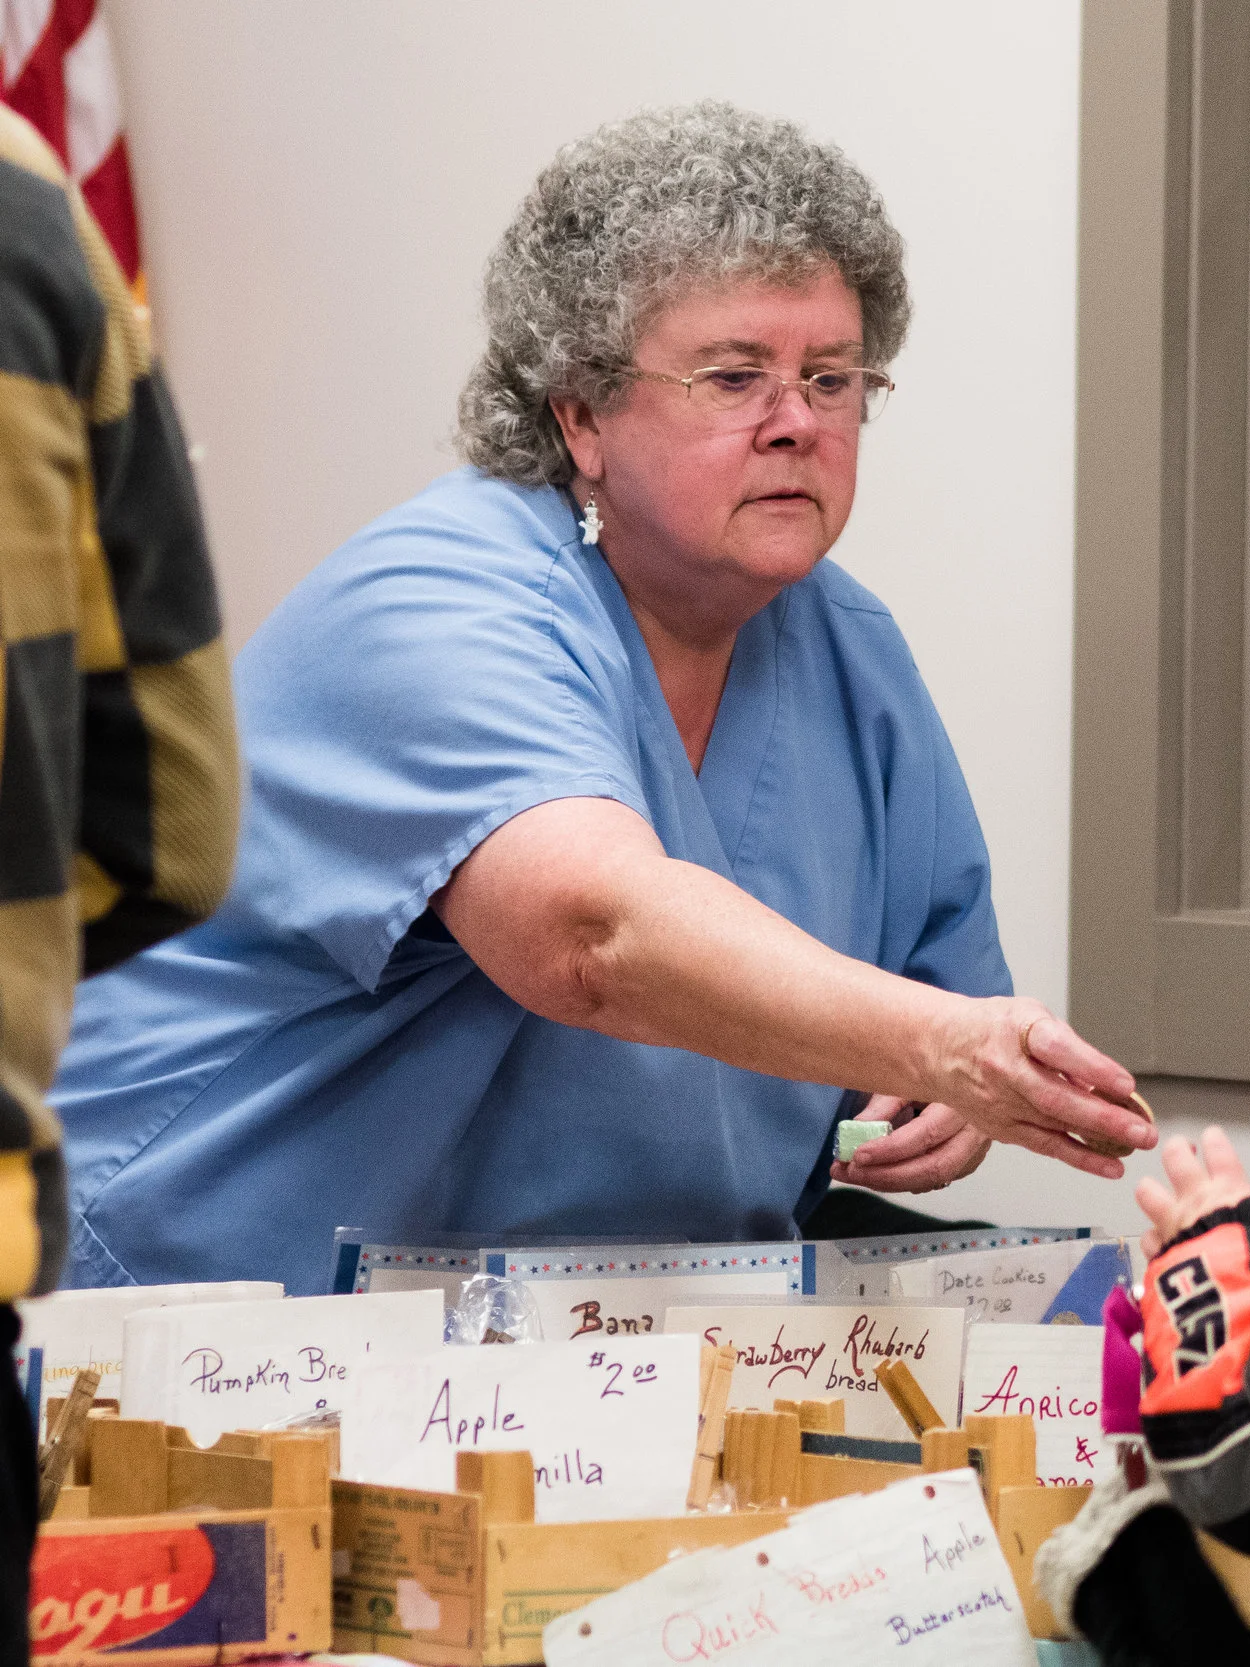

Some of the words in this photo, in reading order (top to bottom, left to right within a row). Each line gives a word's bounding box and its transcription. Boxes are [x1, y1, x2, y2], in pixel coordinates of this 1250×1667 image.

[938, 1270, 984, 1295] Date
[991, 1266, 1046, 1286] Cookies
[569, 1300, 654, 1340] Bana
[298, 1347, 347, 1383] Bre
[704, 1324, 826, 1388] Srawberry
[843, 1314, 930, 1377] Rhubarb
[825, 1359, 878, 1392] bread
[420, 1378, 524, 1444] Apple
[534, 1449, 602, 1488] nilla
[922, 1521, 985, 1574] Apple
[662, 1589, 779, 1662] Quick
